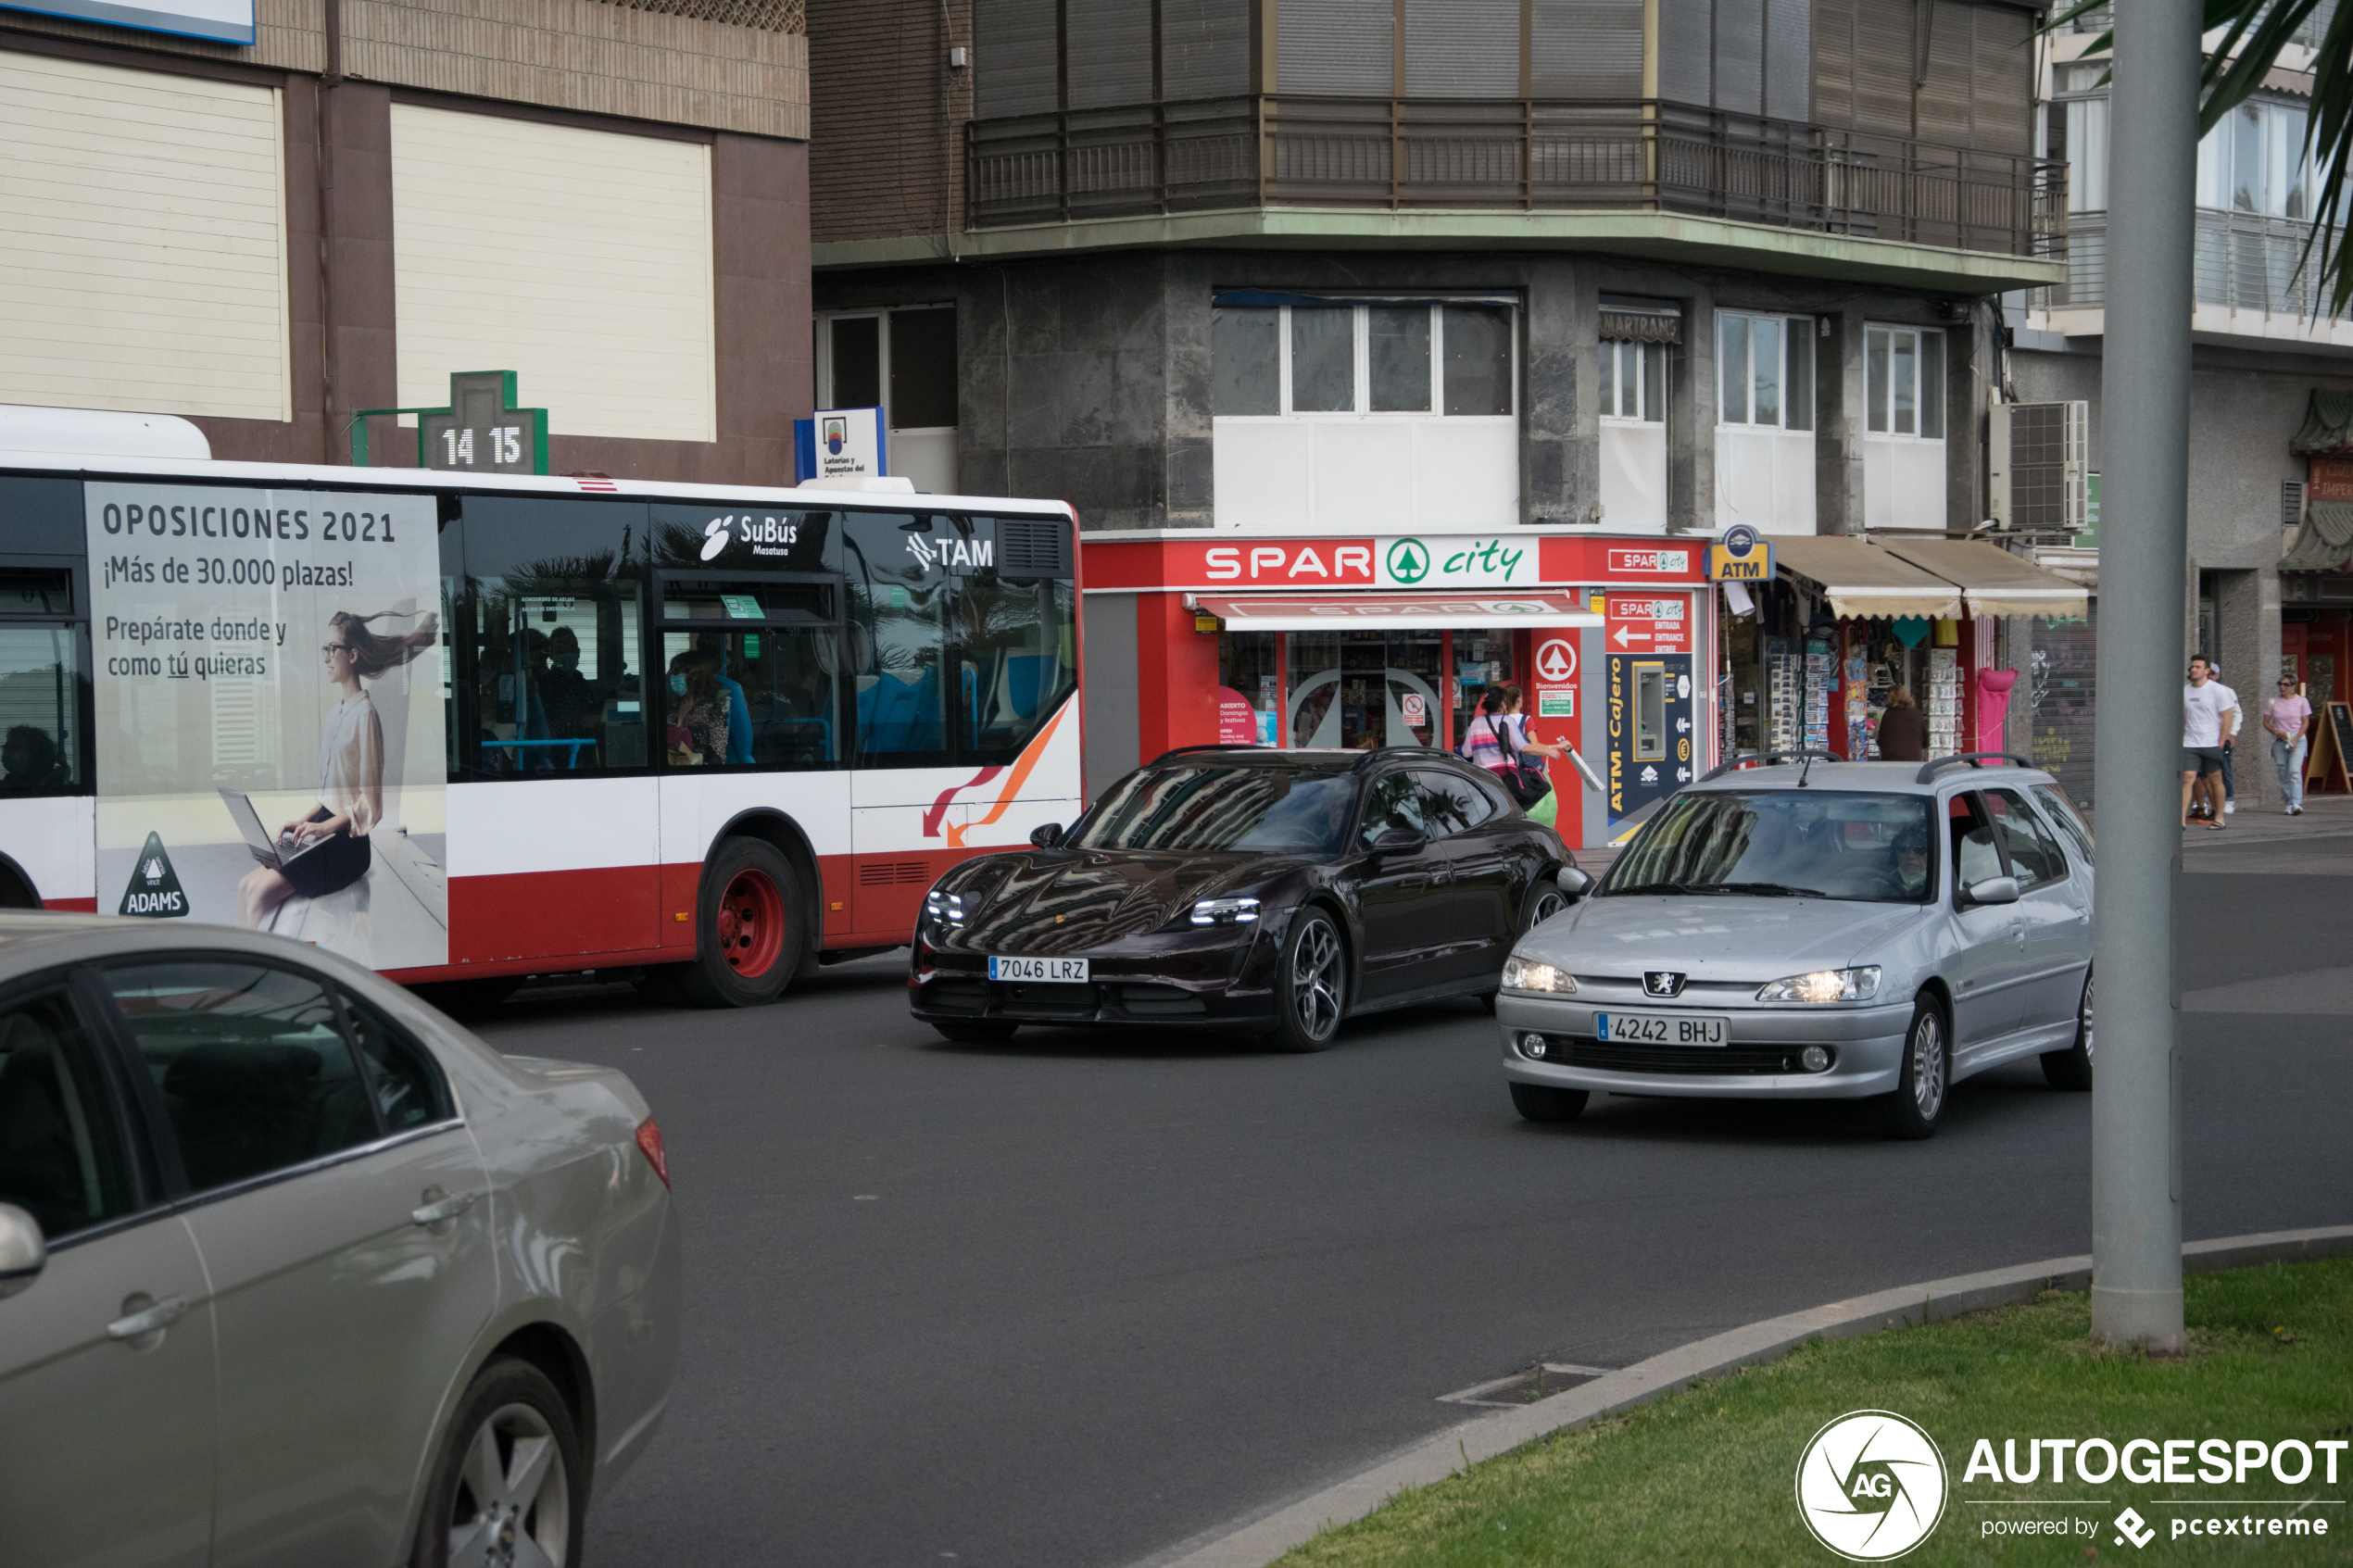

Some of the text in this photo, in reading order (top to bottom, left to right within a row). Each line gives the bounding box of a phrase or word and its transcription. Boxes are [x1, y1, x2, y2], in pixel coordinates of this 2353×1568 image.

[442, 427, 520, 464] 14 15
[824, 464, 864, 474] Apuestas del
[103, 503, 395, 543] OPOSICIONES 2021
[741, 515, 797, 544] SuBús
[752, 545, 788, 556] Masatusa
[936, 538, 993, 567] TAM
[1206, 539, 1524, 582] SPAR city
[1624, 553, 1686, 571] SPAR city
[1721, 562, 1759, 578] ATM
[104, 556, 353, 592] ¡Más de 30.000 plazas!
[1309, 605, 1482, 615] SPAR
[1620, 601, 1684, 619] SPAR city
[107, 615, 286, 646] Prepárate donde y
[1655, 621, 1680, 630] ENTRADA
[1655, 633, 1684, 642] ENTRANCE
[1655, 645, 1677, 653] ENTRÉE
[108, 651, 266, 681] como tú quieras
[1609, 658, 1624, 812] ATM Cajero
[127, 891, 181, 913] ADAMS
[1001, 960, 1044, 978] 7046
[1051, 961, 1084, 979] LRZ
[1615, 1018, 1667, 1040] 4242
[1679, 1021, 1720, 1043] BHJ
